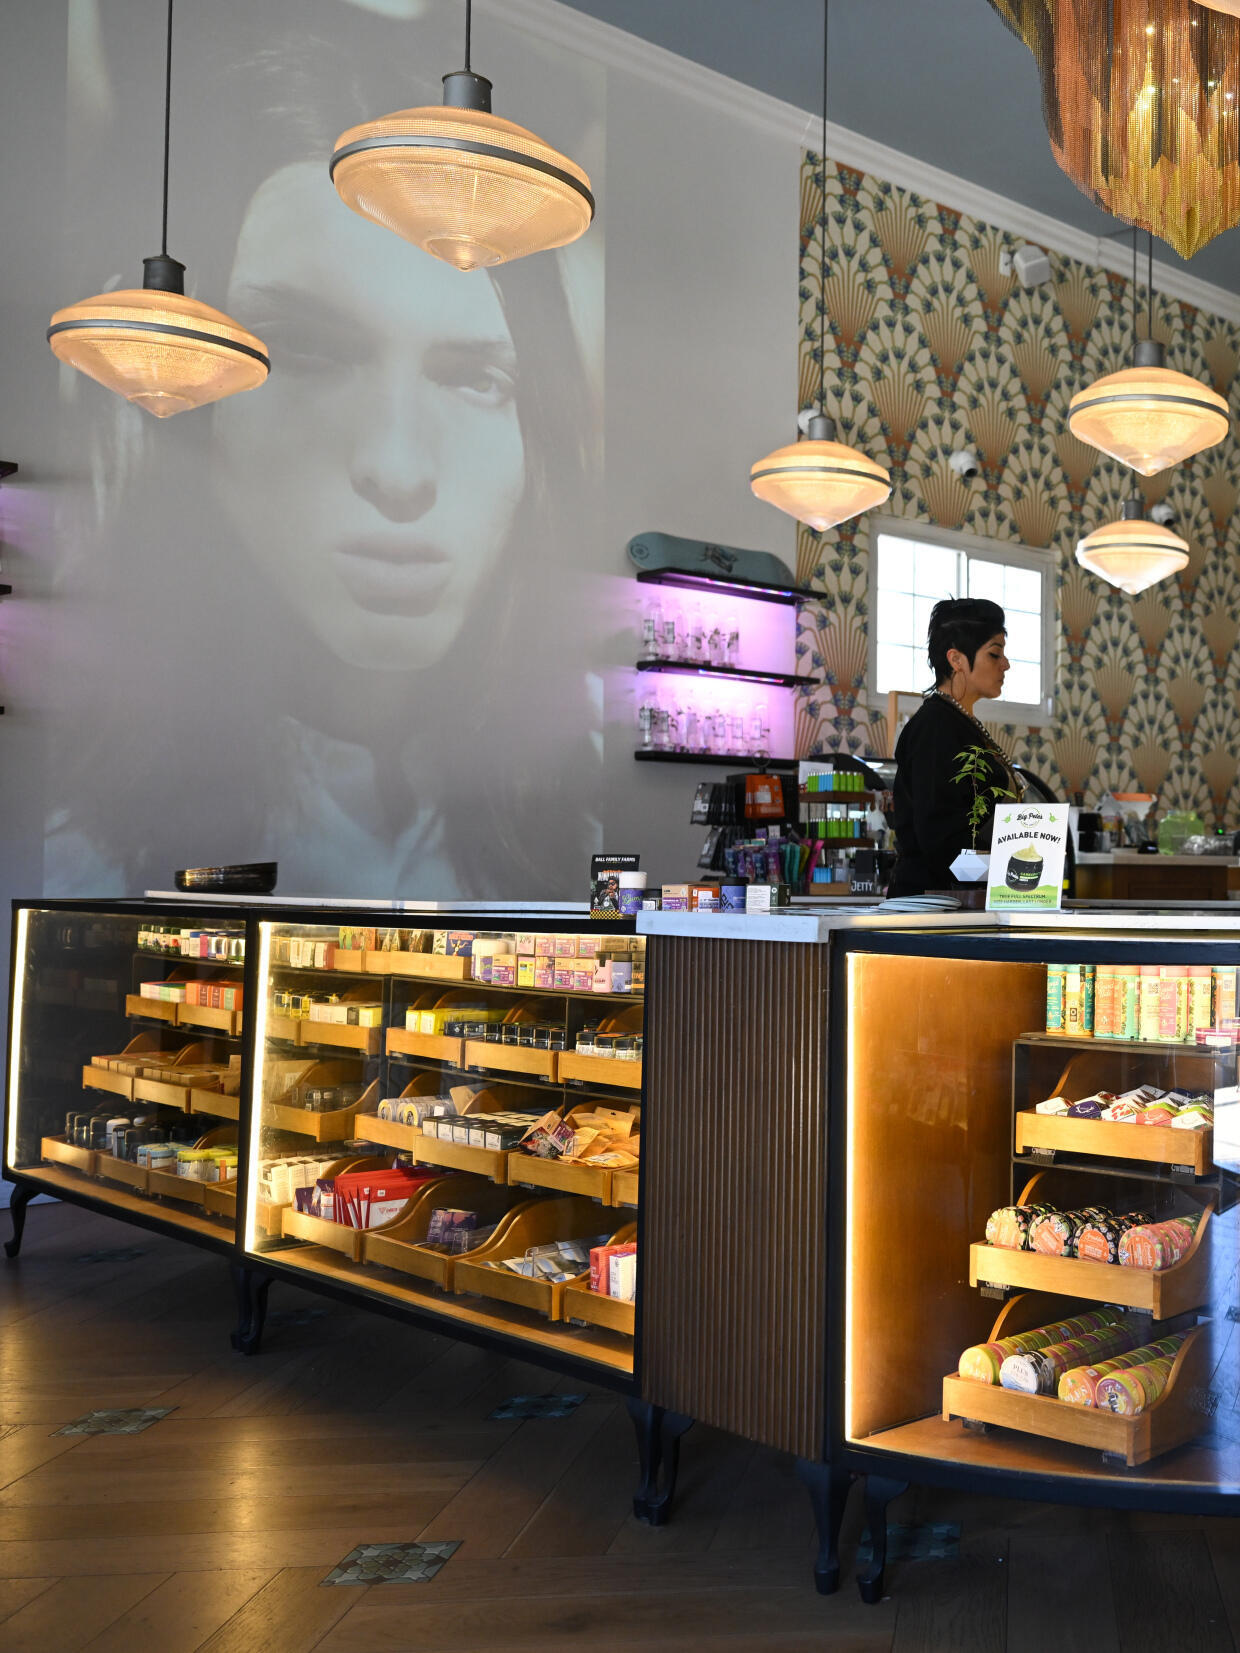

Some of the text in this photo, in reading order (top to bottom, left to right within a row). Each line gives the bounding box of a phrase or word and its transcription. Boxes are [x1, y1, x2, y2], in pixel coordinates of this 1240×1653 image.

[997, 831, 1061, 845] AVAILABLE NOW!
[851, 880, 873, 892] JETTY
[1064, 1386, 1089, 1403] PLUS
